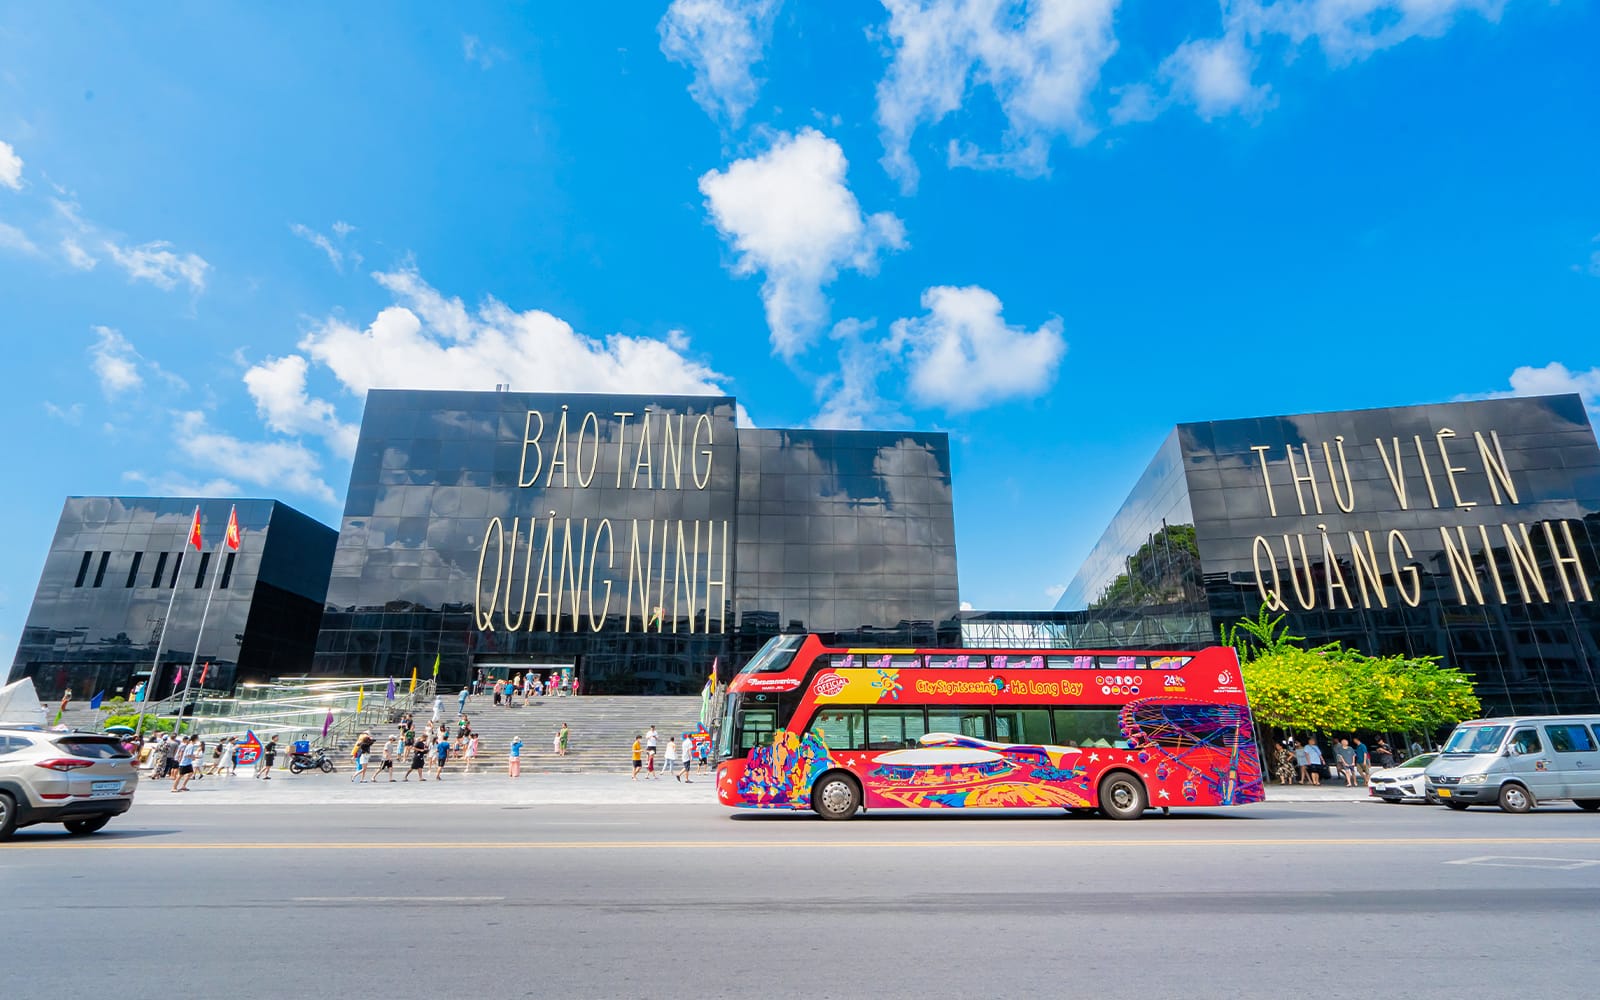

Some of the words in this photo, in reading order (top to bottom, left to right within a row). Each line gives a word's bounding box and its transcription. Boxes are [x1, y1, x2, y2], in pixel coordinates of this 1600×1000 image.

[518, 404, 599, 489] BẢO
[613, 407, 713, 490] TÀNG
[1375, 427, 1520, 512] VIỆN
[475, 510, 614, 633] QUẢNG
[625, 518, 728, 634] NINH
[1252, 523, 1421, 612] QUẢNG
[1440, 520, 1594, 606] NINH
[817, 678, 847, 692] OFFICIAL
[1010, 680, 1027, 695] Ha
[1029, 679, 1059, 697] Long
[1061, 680, 1083, 696] Bay
